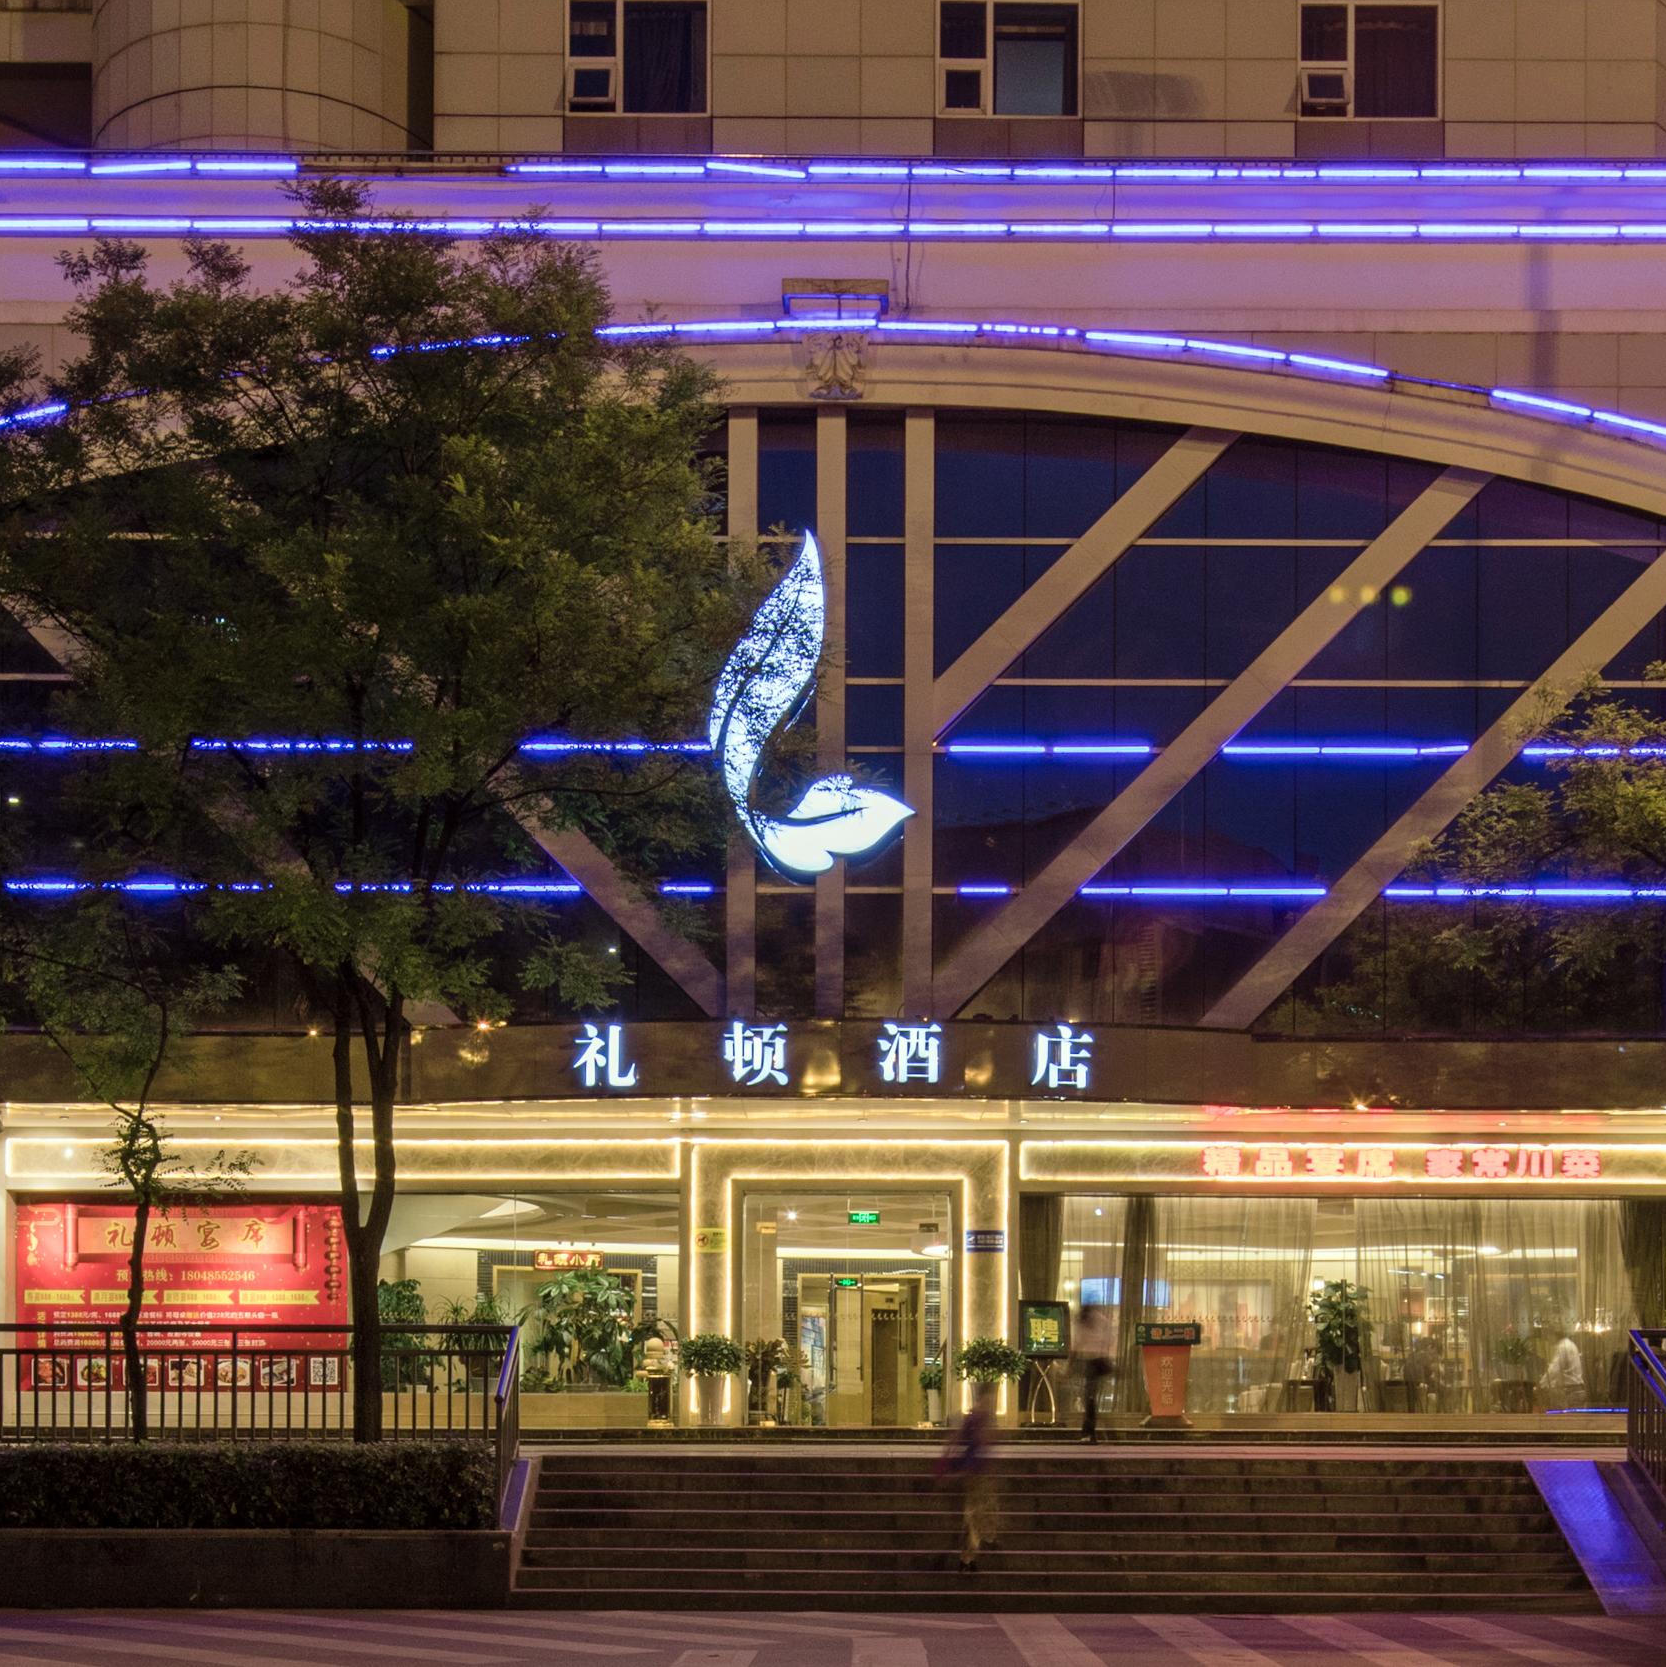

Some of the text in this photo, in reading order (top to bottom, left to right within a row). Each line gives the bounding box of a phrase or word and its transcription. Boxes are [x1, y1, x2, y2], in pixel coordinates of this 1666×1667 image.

[573, 1022, 1094, 1089] 礼顿酒店
[1202, 1146, 1602, 1179] 精品宴席 家常川菜
[107, 1220, 265, 1250] 礼顿宴席
